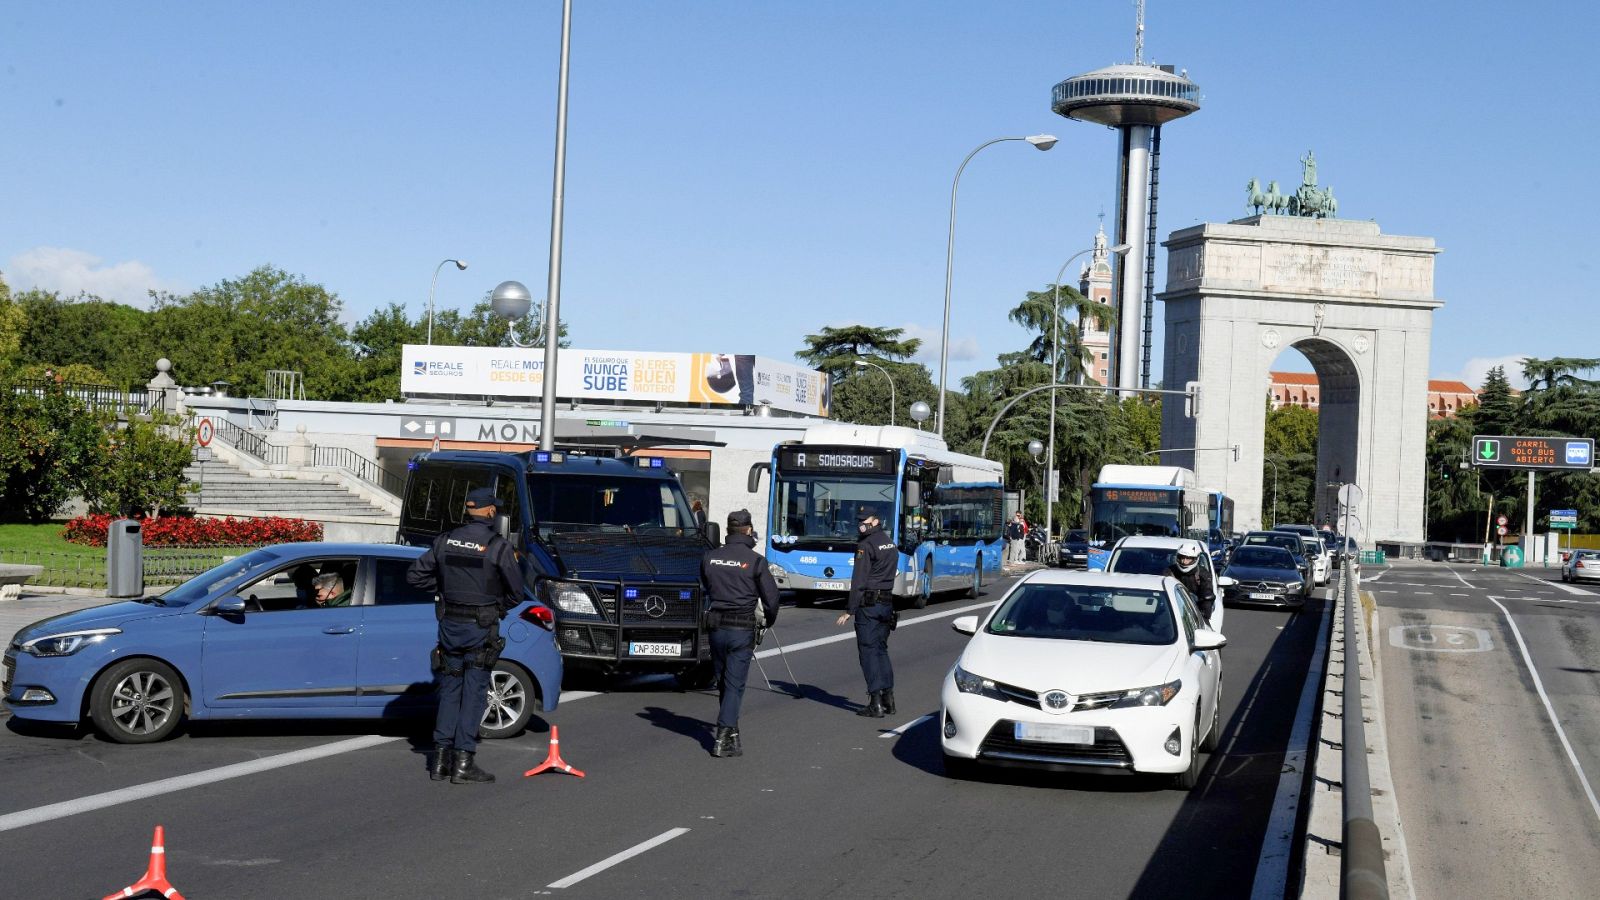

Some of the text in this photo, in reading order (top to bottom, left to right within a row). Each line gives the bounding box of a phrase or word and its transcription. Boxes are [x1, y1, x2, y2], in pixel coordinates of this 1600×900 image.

[429, 362, 464, 370] REALE
[491, 360, 520, 369] REALE
[583, 363, 628, 376] NUNCA
[634, 359, 676, 370] SI ERES
[491, 371, 526, 382] DESDE
[633, 369, 676, 384] BUEN
[583, 375, 628, 391] SUBE
[633, 384, 675, 393] MOTERO
[1516, 440, 1549, 448] CARRIL
[797, 453, 874, 468] A SOMOSAGUAS
[446, 538, 482, 551] POLICIA
[710, 559, 742, 567] POLICIA
[799, 556, 818, 564] 4856
